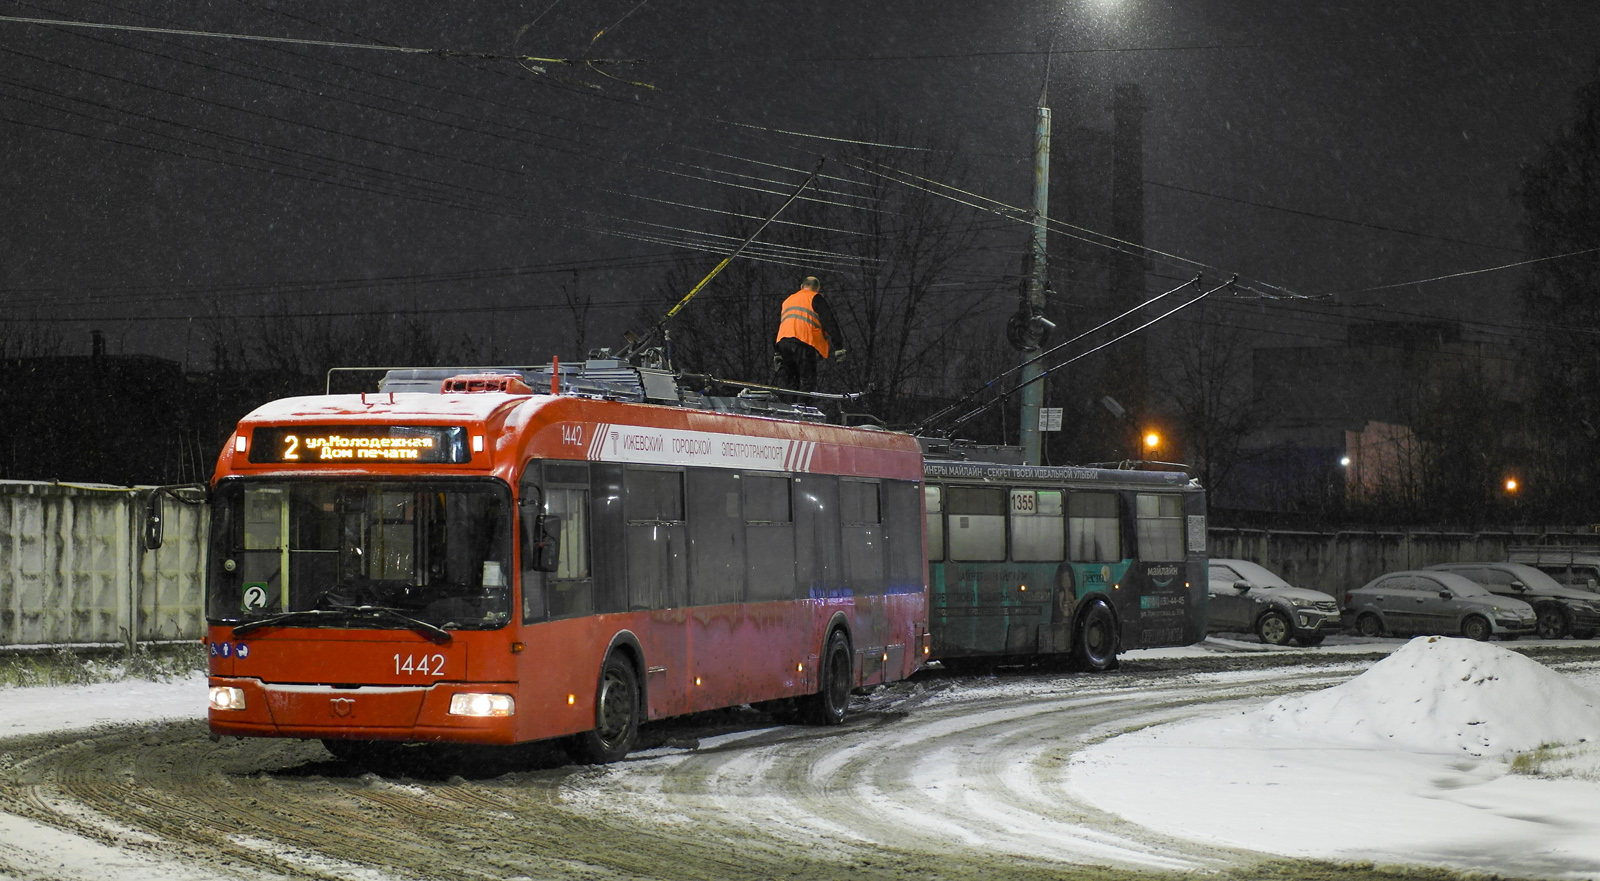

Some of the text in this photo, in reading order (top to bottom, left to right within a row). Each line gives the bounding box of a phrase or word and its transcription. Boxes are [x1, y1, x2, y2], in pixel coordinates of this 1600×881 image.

[305, 435, 433, 448] ул.Молодежная
[562, 424, 583, 446] 1442
[284, 435, 299, 459] 2
[320, 447, 418, 459] Дом печати
[623, 434, 783, 460] ИЖЕВСКИЙ ГОРОДСКОЙ ЭЛЕКТРОТРАНСПОРТ
[948, 465, 982, 477] МАЙЛАЙН
[987, 467, 1011, 478] СЕКРЕТ
[1012, 468, 1034, 478] ТВОЕЙ
[1034, 469, 1073, 479] ИДЕАЛЬНОЙ
[1073, 469, 1099, 480] УЛЫБКИ
[1011, 493, 1034, 511] 1355
[1147, 564, 1179, 576] майлайн
[249, 588, 261, 608] 2
[393, 653, 445, 676] 1442
